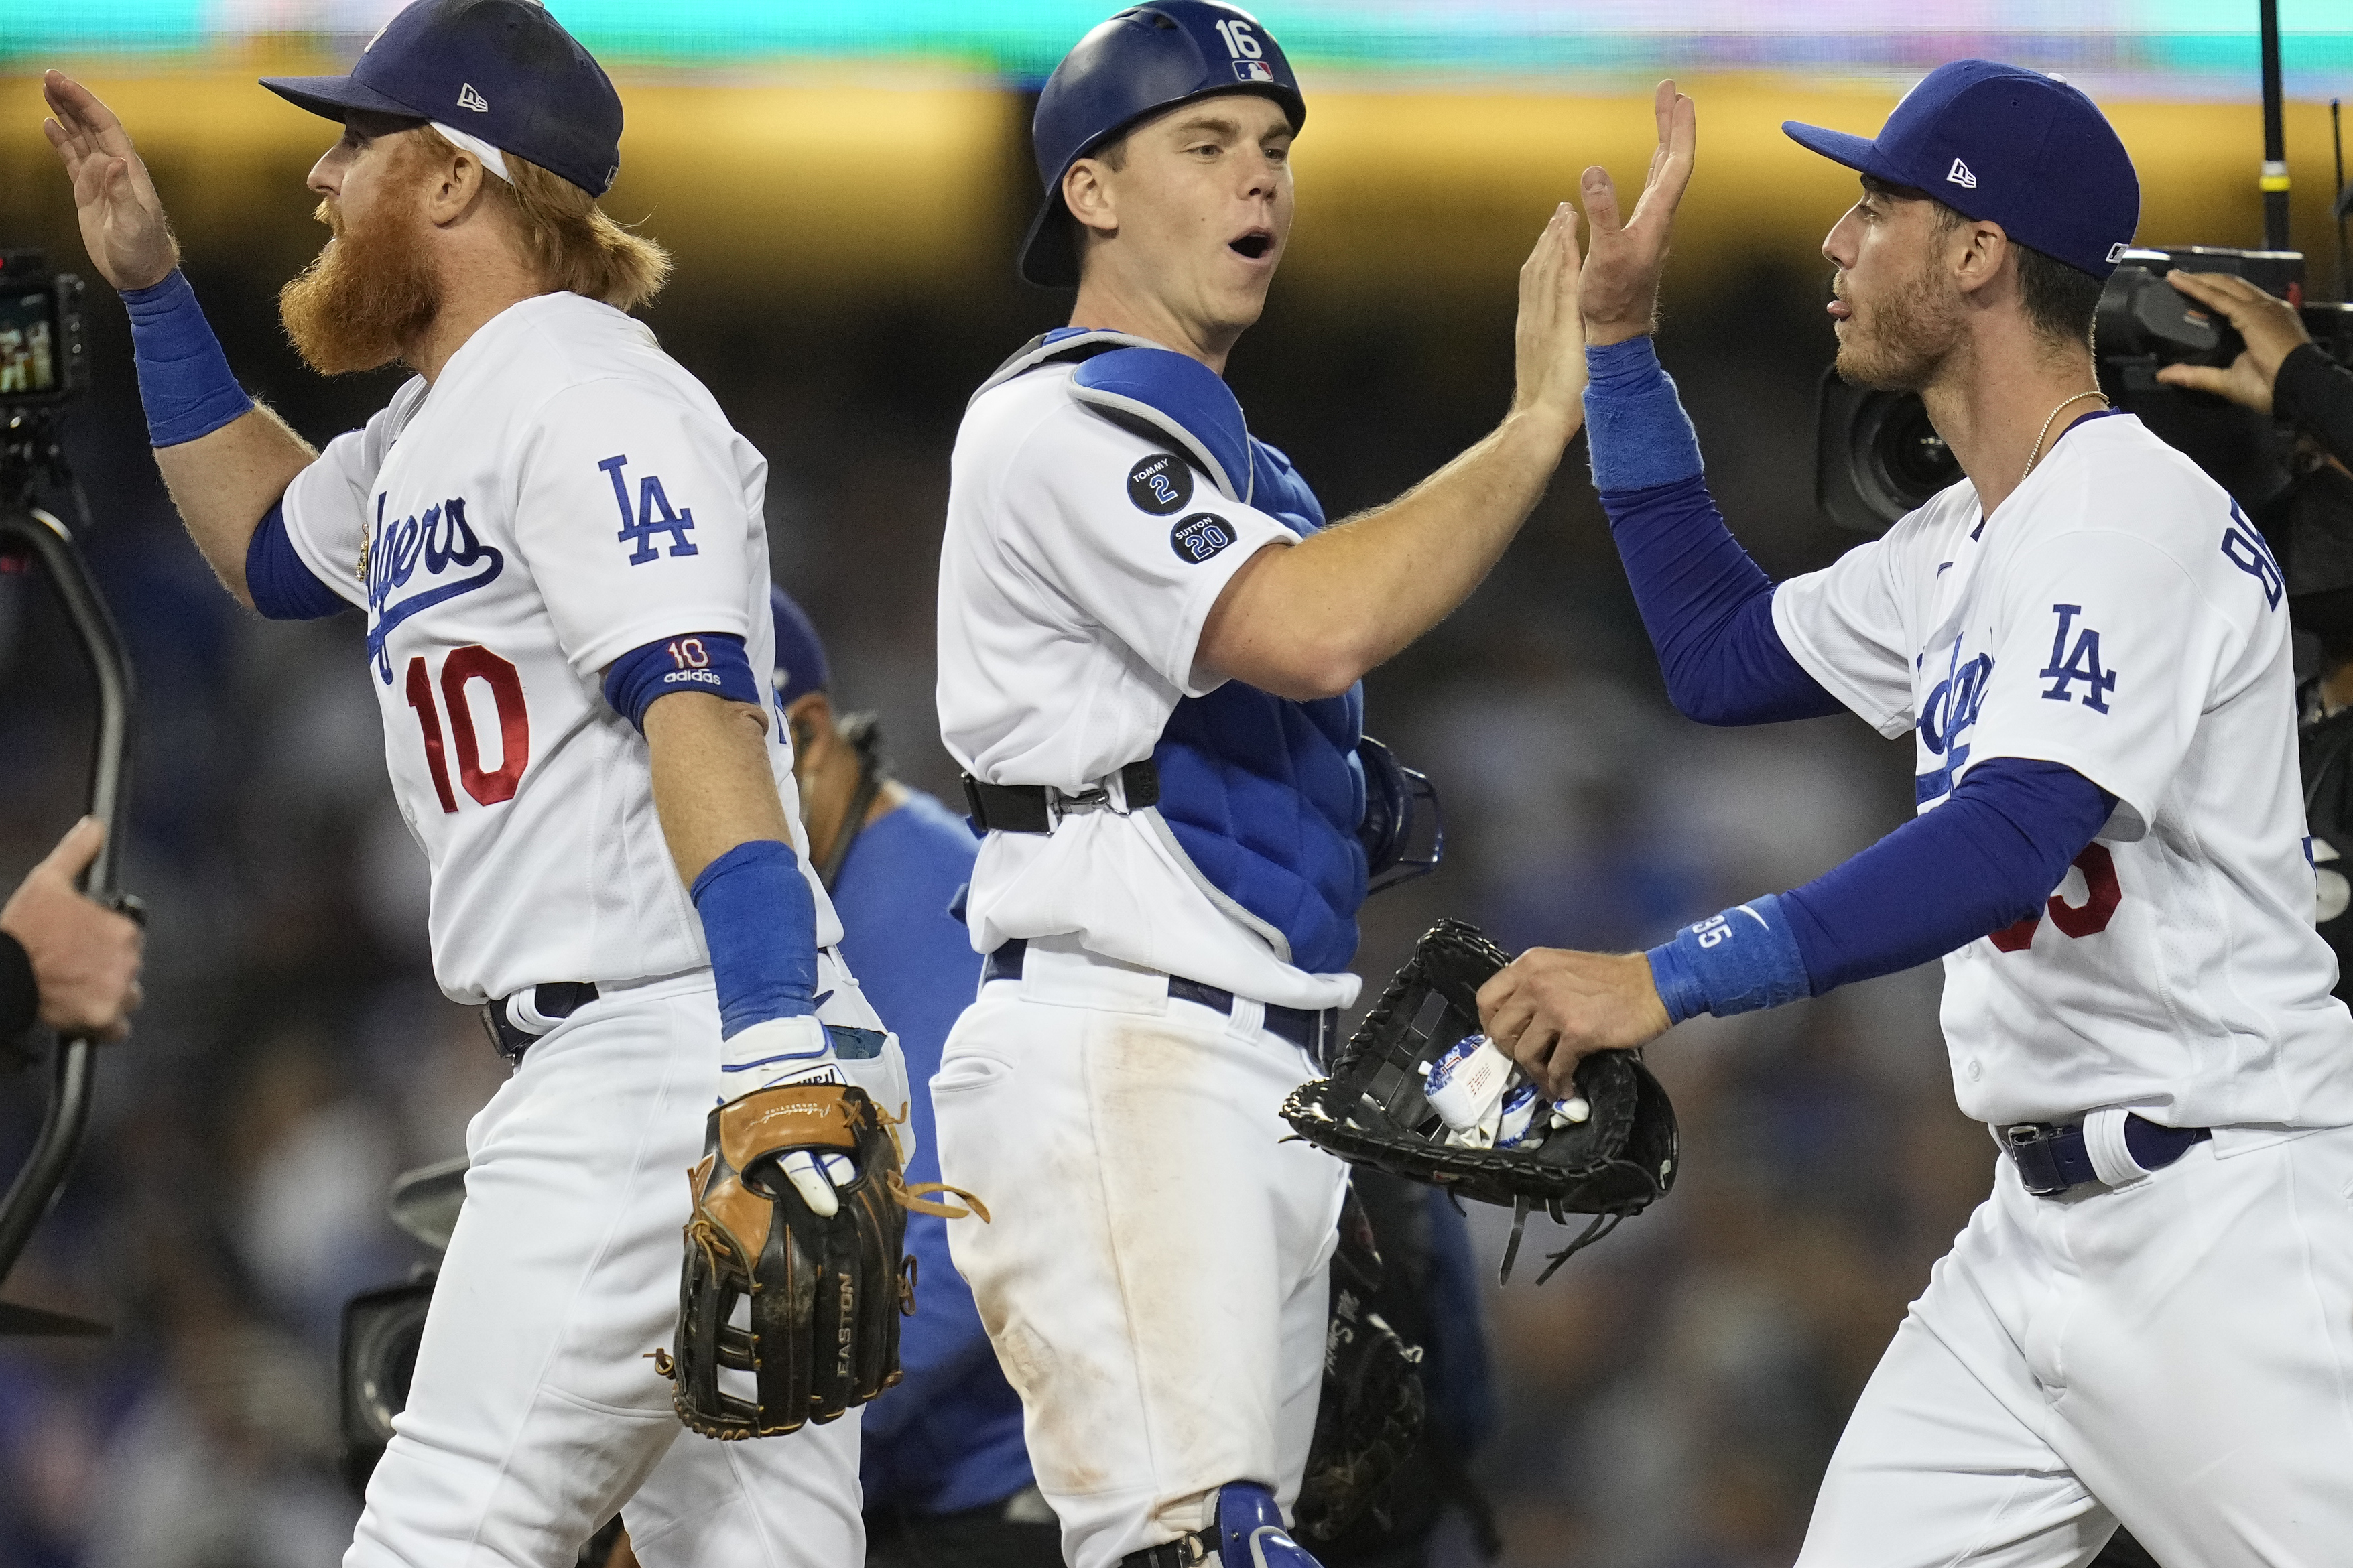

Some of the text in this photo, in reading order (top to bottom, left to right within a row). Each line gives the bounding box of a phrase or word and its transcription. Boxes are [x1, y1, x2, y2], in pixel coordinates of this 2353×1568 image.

[1215, 19, 1263, 59] 16
[1132, 458, 1169, 483] TOMMY
[1149, 474, 1179, 505] 2
[598, 454, 699, 566] LA
[1175, 516, 1213, 540] SUTTON
[1184, 525, 1228, 560] 20
[366, 491, 504, 685] dgers
[667, 638, 709, 669] 10
[2039, 604, 2117, 715] LA
[663, 669, 722, 685] adidas
[405, 645, 529, 813] 10
[1692, 914, 1733, 948] 35
[837, 1272, 854, 1378] EASTON
